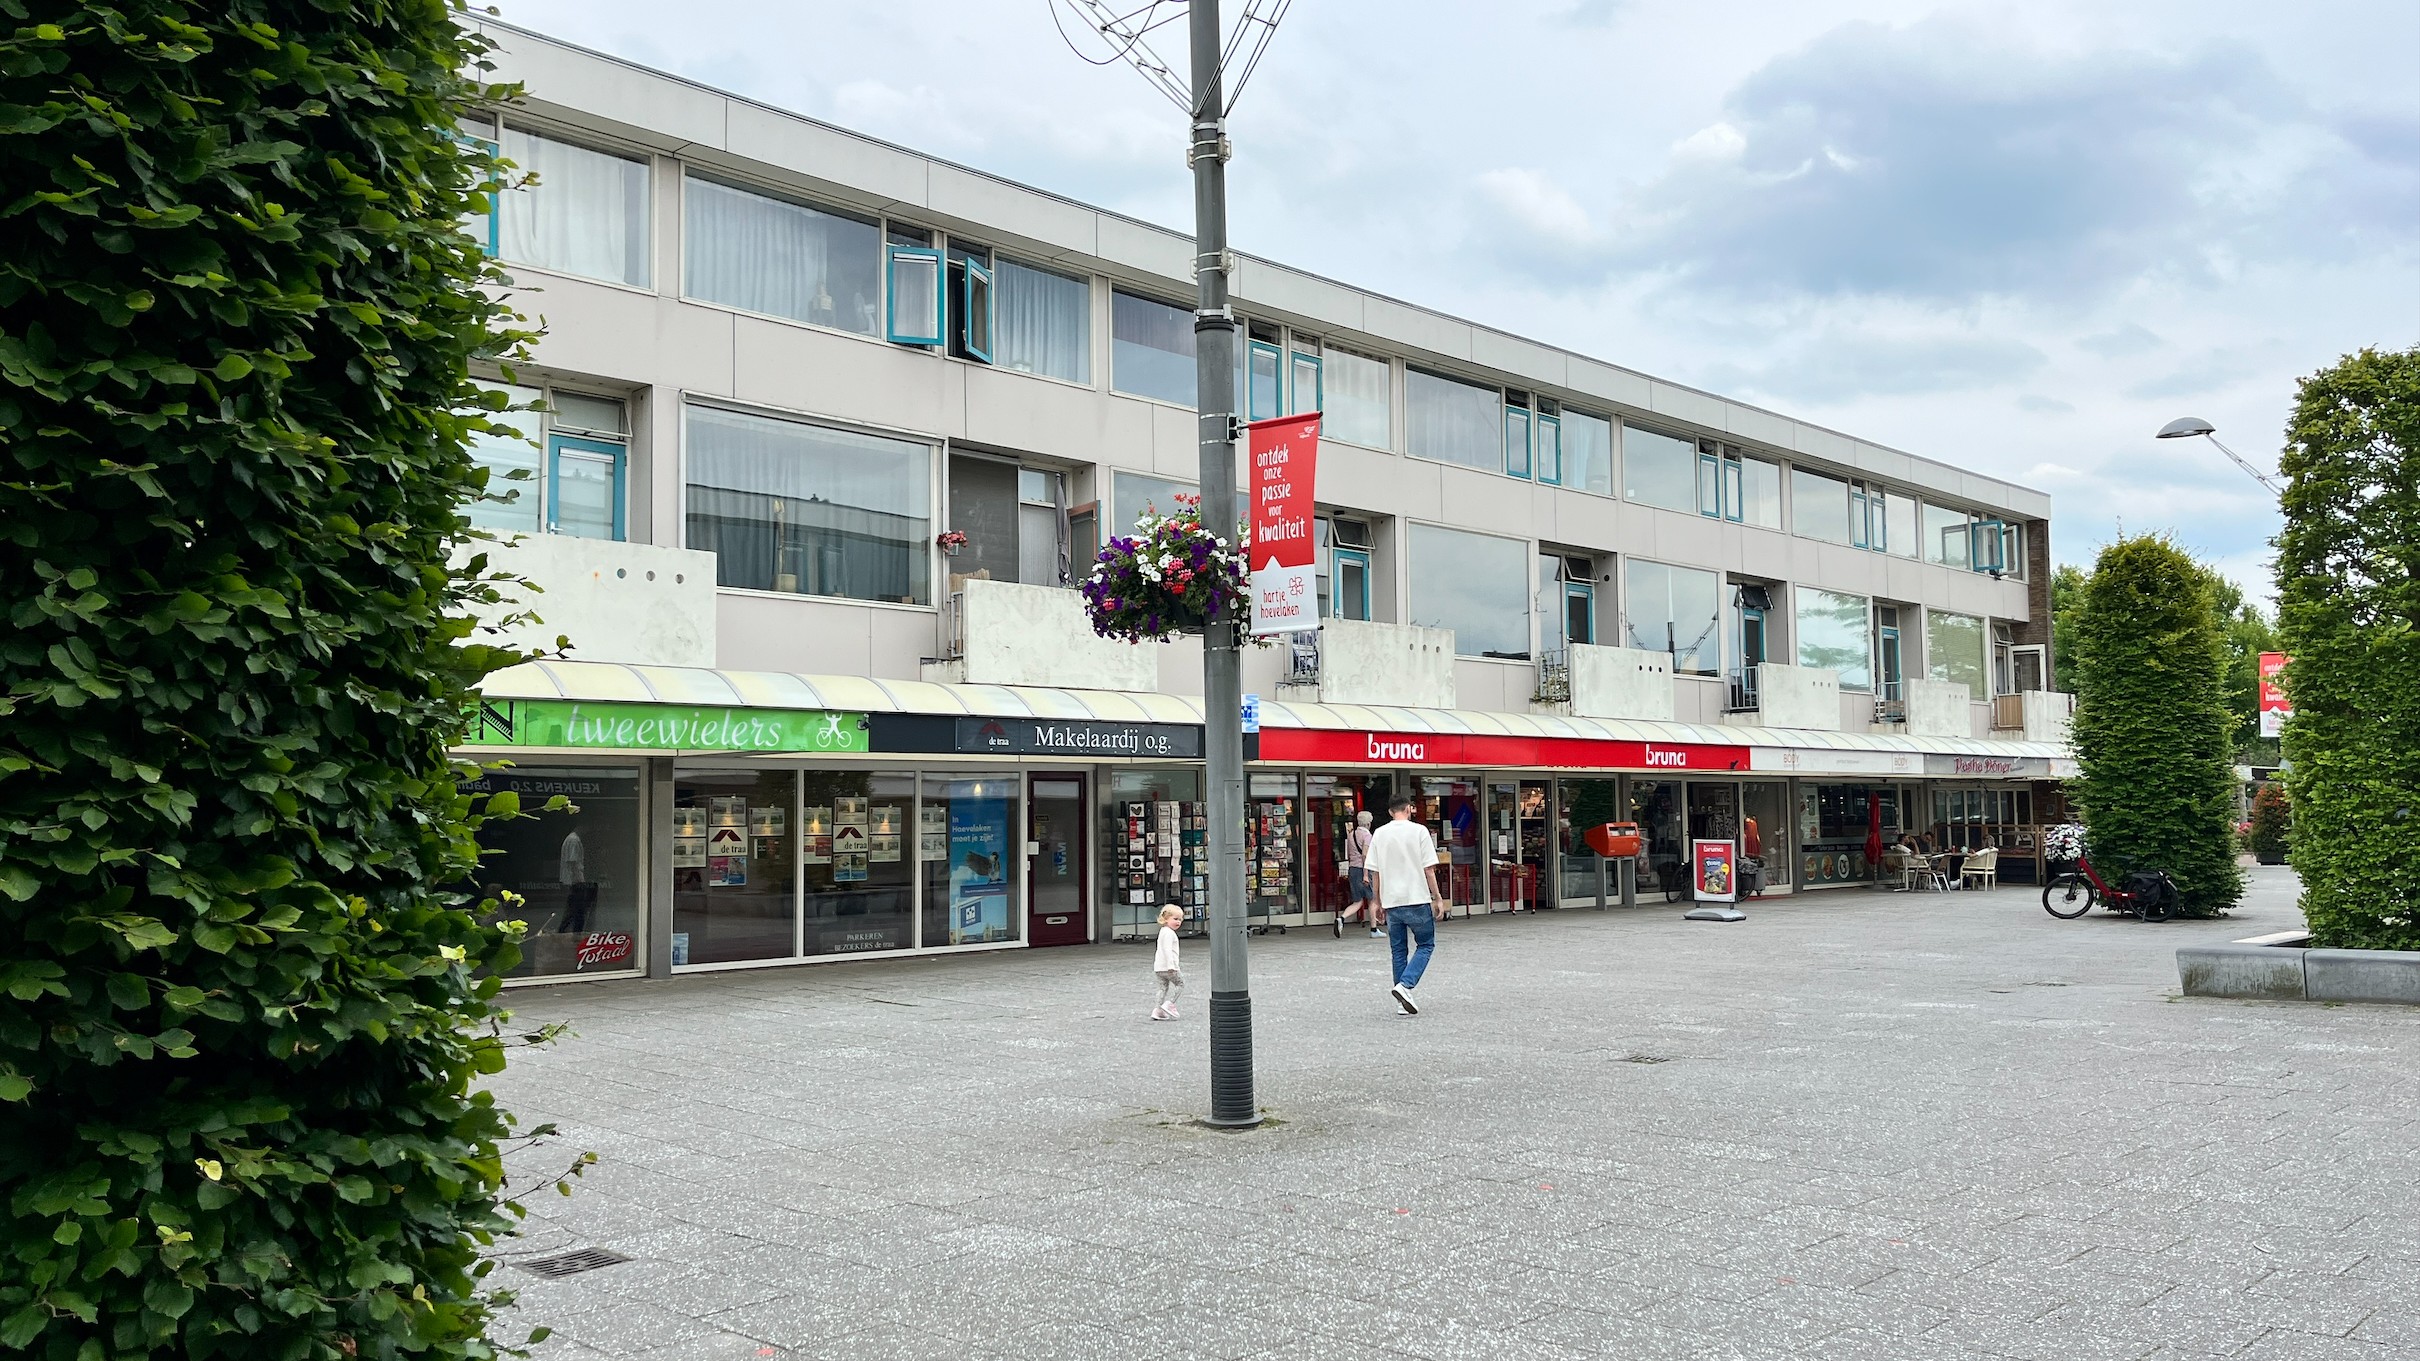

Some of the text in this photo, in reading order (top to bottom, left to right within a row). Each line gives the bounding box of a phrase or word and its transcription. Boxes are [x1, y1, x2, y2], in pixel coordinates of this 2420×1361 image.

[1257, 443, 1289, 467] ontdek
[1263, 466, 1282, 480] onze
[1262, 478, 1291, 506] passie
[1268, 505, 1283, 517] voor
[1259, 516, 1305, 543] kwaliteit
[1263, 587, 1286, 603] hartje
[1260, 601, 1300, 619] hoevelaken
[567, 704, 782, 747] tweewielers
[988, 736, 1010, 746] de traa
[1035, 725, 1172, 754] Makelaardij o.g.
[1367, 733, 1424, 760] bruna
[1645, 743, 1686, 766] bruna
[1954, 756, 1983, 774] Pasha
[720, 845, 746, 853] de traa
[844, 841, 852, 850] de
[1703, 844, 1724, 853] bruna
[586, 931, 627, 946] Bike
[846, 932, 884, 941] PARKEREN
[577, 939, 631, 970] Totaal
[834, 942, 873, 952] BEZOEKERS
